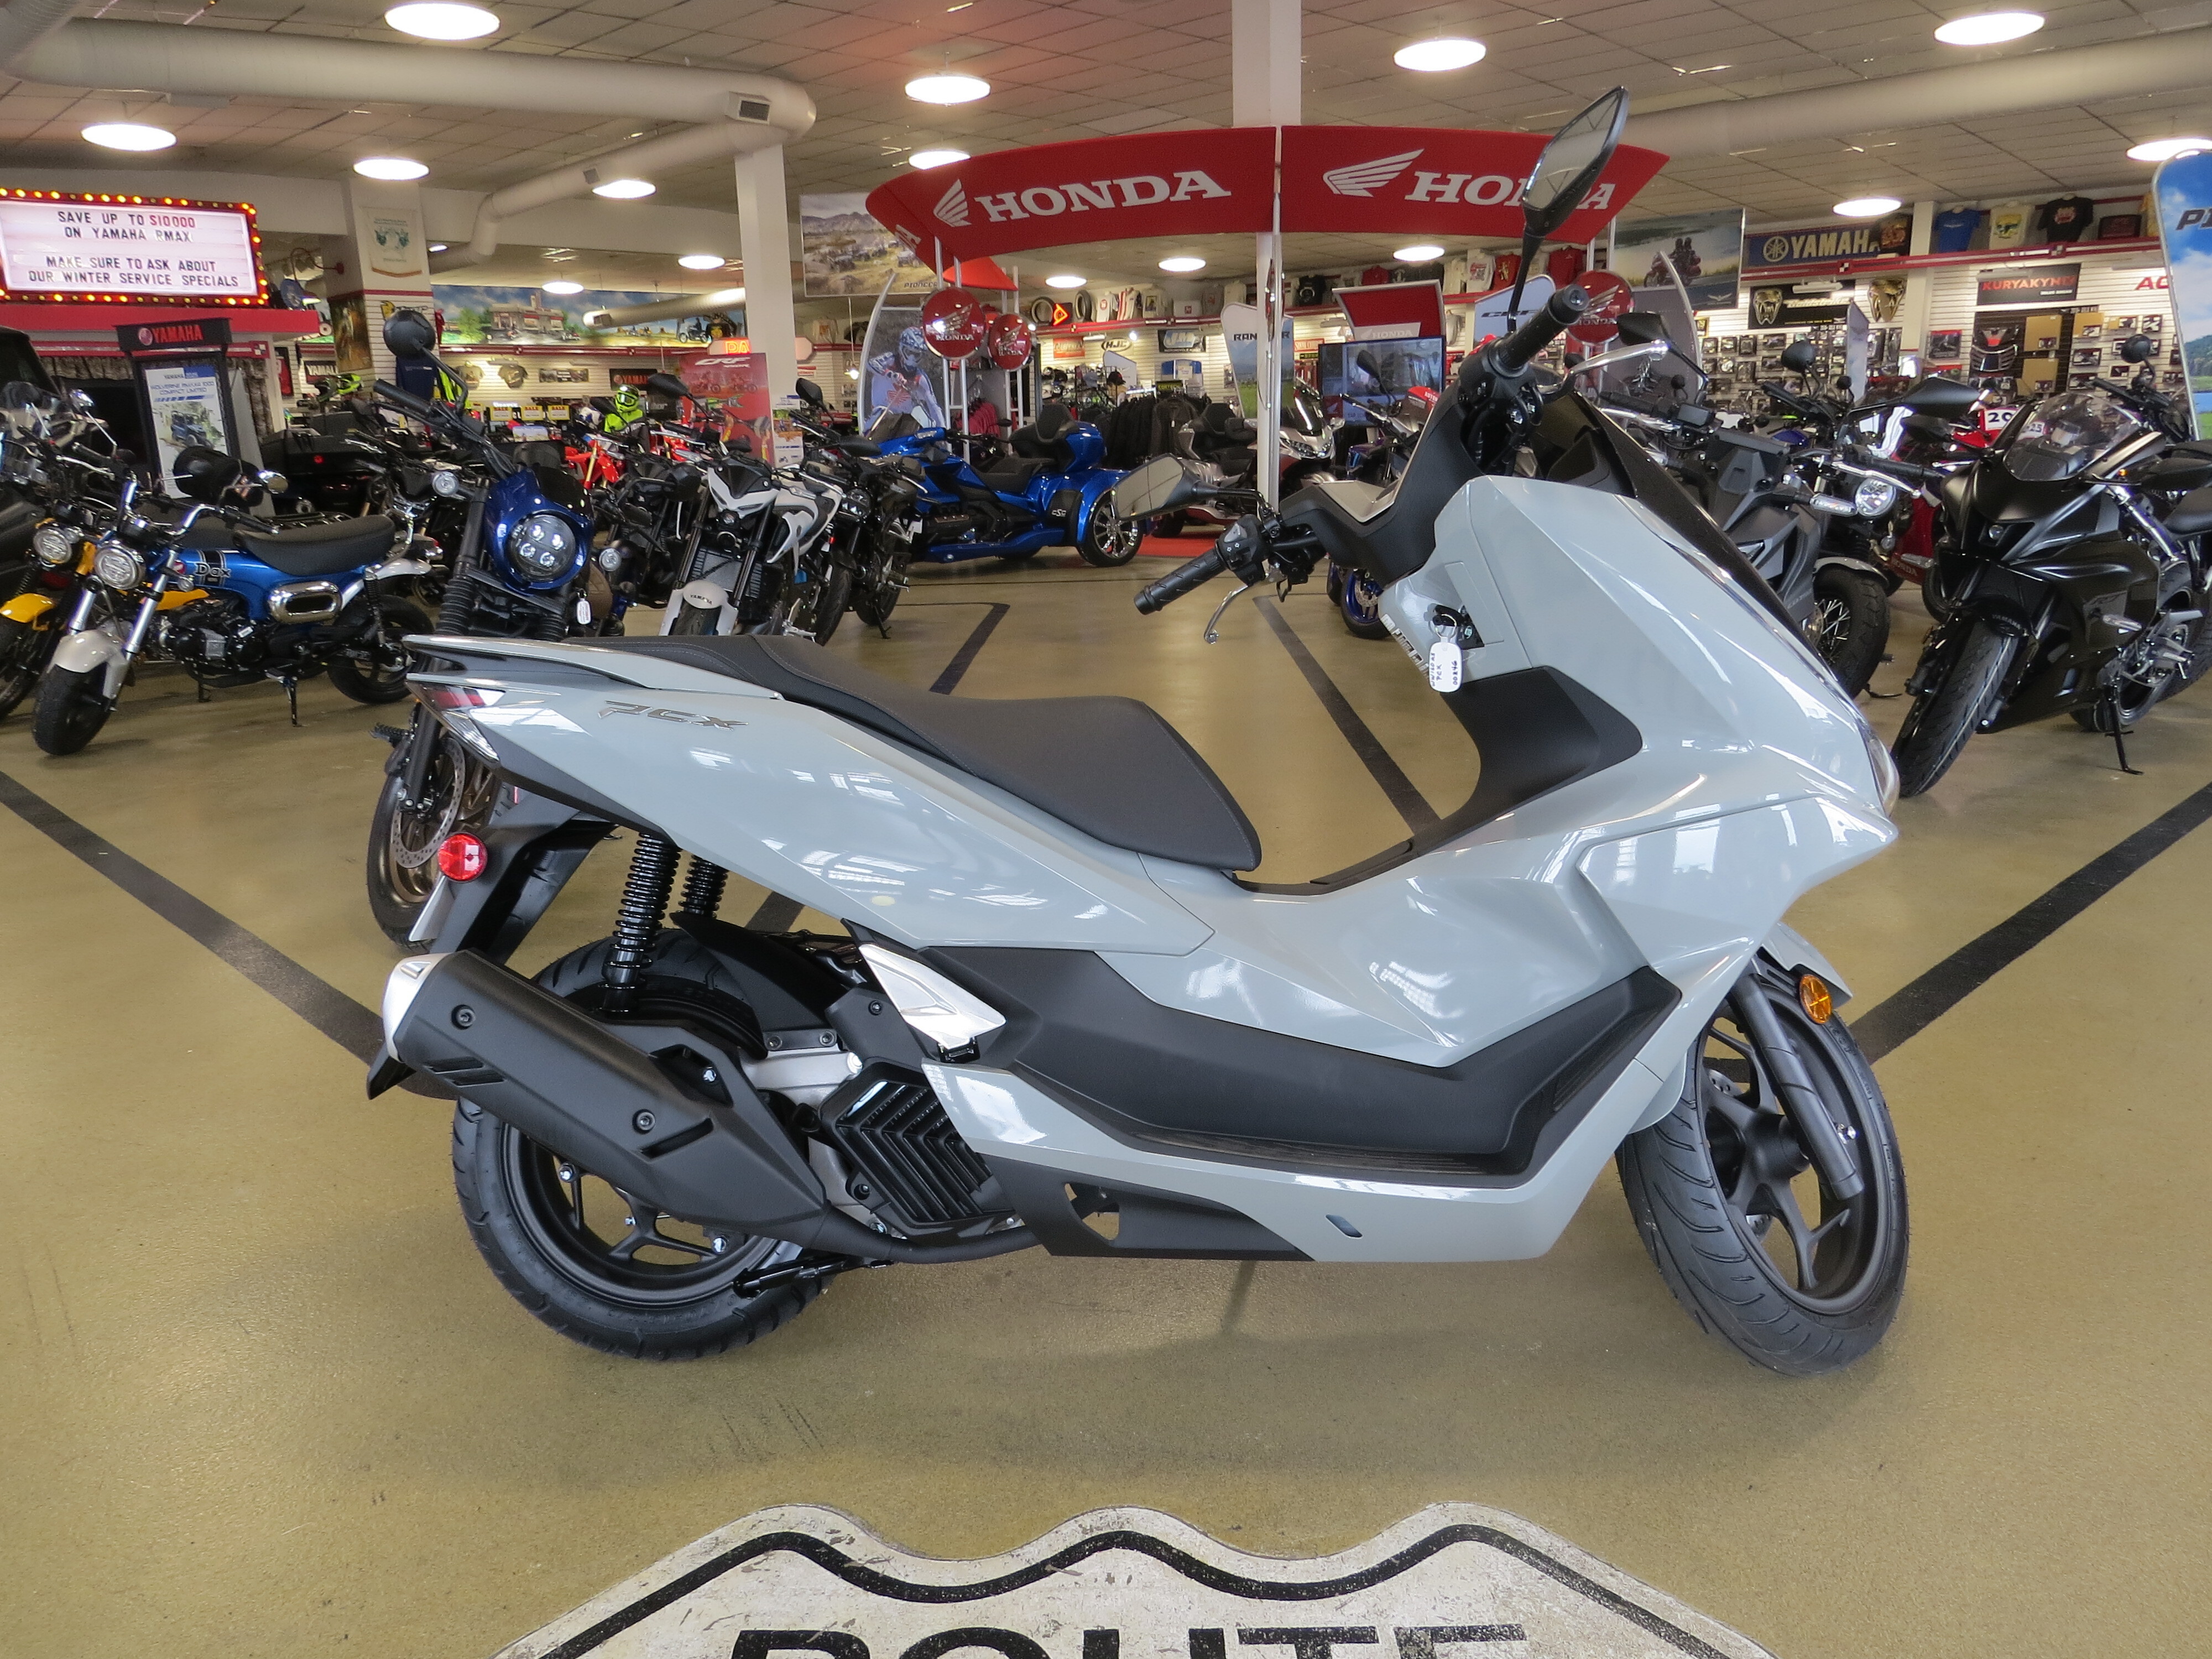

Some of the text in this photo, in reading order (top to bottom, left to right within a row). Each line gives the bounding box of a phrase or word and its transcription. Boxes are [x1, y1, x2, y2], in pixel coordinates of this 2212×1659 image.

[974, 170, 1232, 222] HONDA
[1404, 171, 1616, 210] HOA
[58, 211, 91, 223] SAVE
[102, 213, 118, 225] UP
[128, 214, 144, 226] TO
[65, 227, 81, 238] ON
[93, 228, 147, 241] YAMAHA
[46, 256, 216, 273] MAKE SURE TO ASK ABOUT
[28, 271, 239, 287] OUR WINTER SERVICE SPECIALS
[152, 325, 203, 343] YAMAHA
[1234, 332, 1290, 341] RANR
[695, 357, 750, 366] CRF
[194, 561, 232, 578] Dax
[690, 594, 713, 605] YAMAHA
[1992, 614, 2021, 629] YAMAHA
[598, 700, 748, 731] PCX
